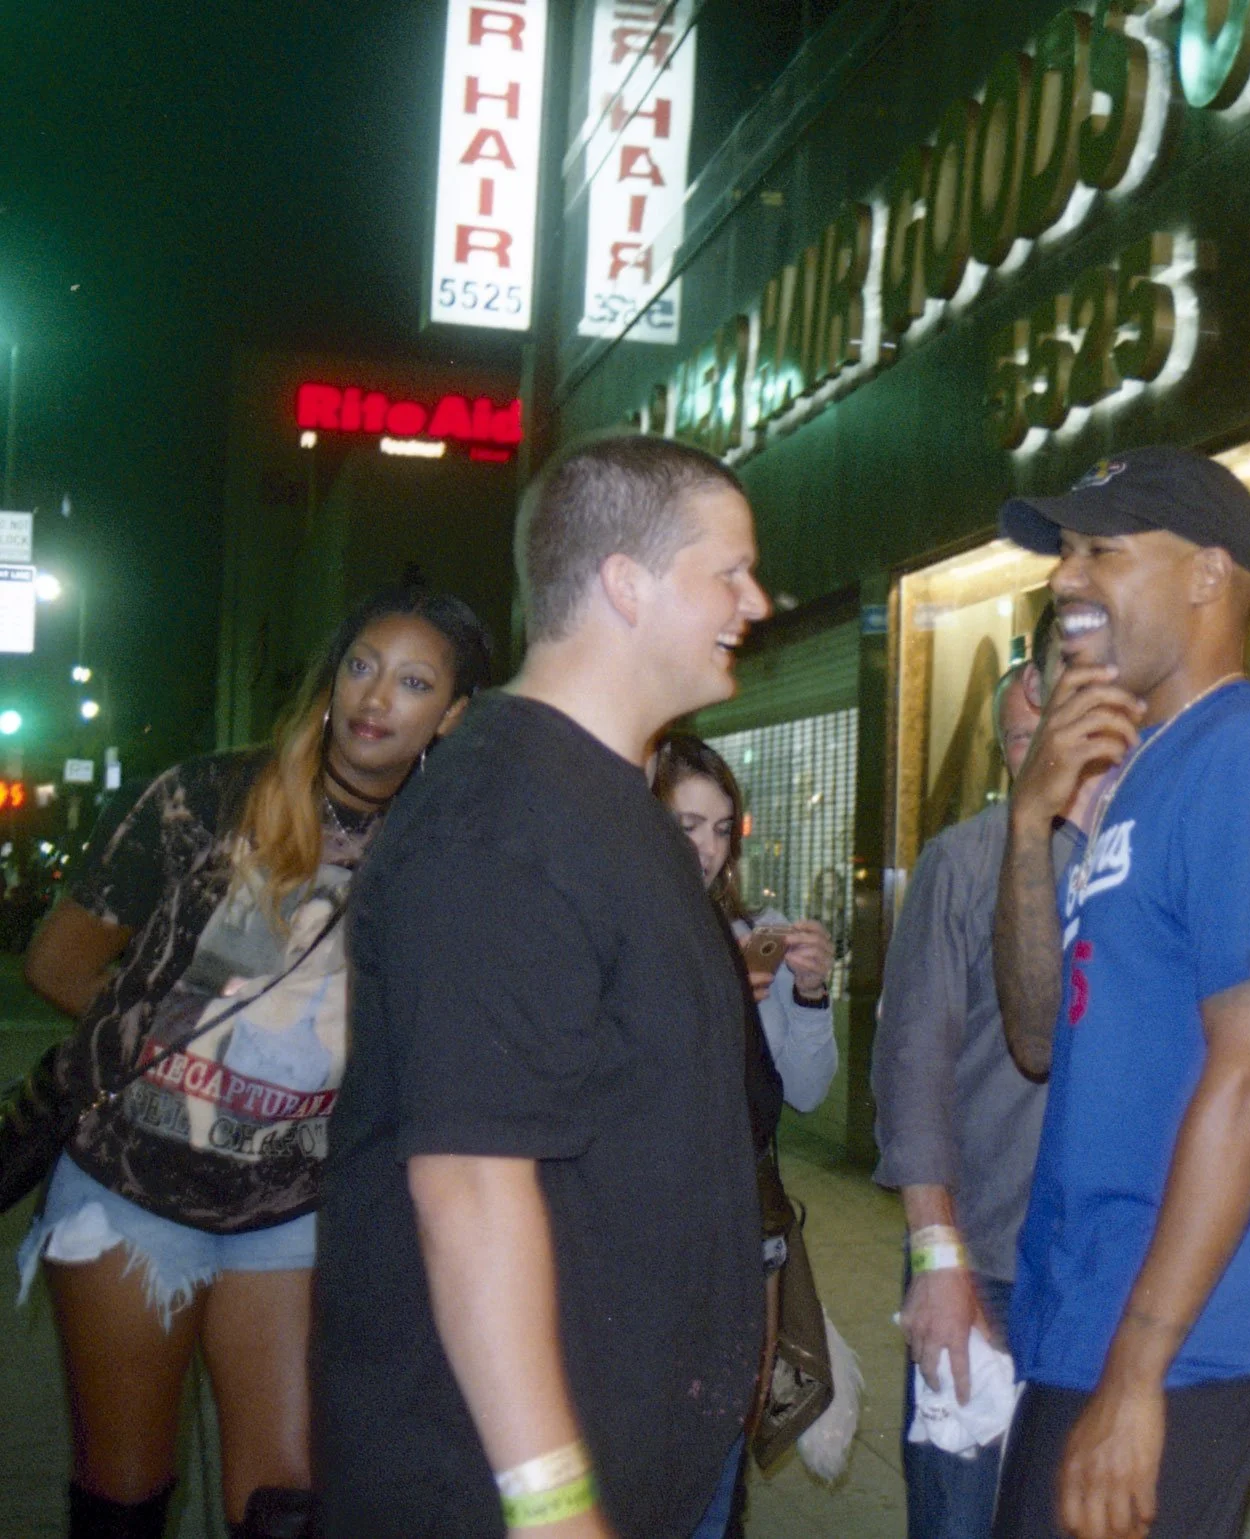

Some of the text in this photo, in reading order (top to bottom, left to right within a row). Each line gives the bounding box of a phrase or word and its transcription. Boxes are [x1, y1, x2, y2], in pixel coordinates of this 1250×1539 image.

[453, 75, 521, 269] HAIR
[880, 0, 1170, 340] GOODS
[438, 277, 522, 315] 5525
[990, 228, 1198, 455] 5525
